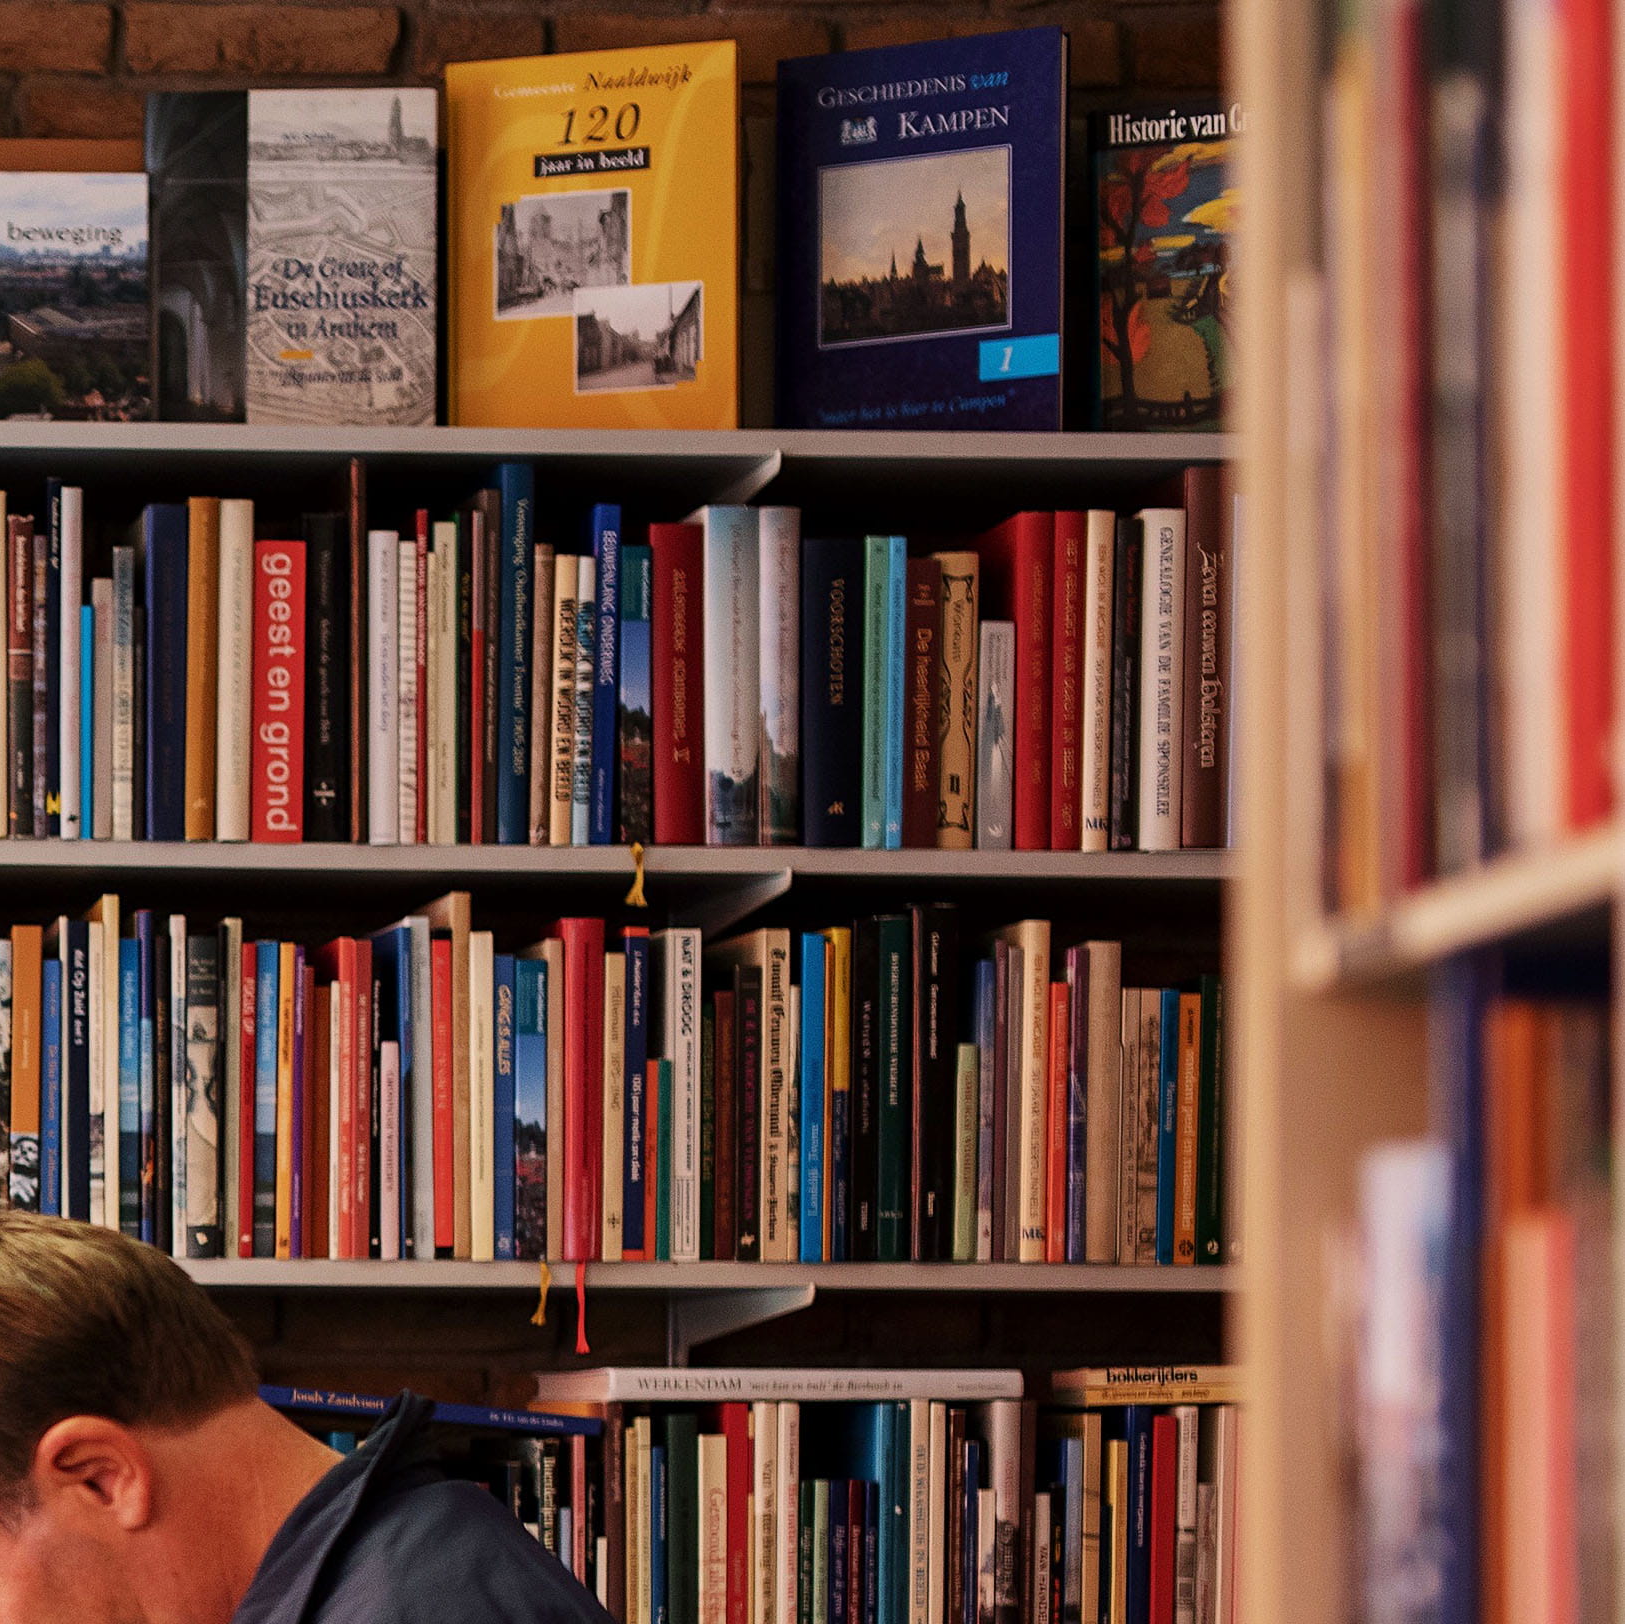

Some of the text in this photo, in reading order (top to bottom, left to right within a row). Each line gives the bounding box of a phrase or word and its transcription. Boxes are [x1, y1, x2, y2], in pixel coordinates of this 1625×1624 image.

[583, 62, 693, 92] Naaldwijk
[556, 101, 642, 147] 120
[898, 105, 1011, 141] KAMPEN
[1189, 105, 1227, 137] van
[539, 148, 646, 176] jaar in beeld
[6, 223, 124, 247] beweging
[282, 258, 314, 279] De
[317, 314, 399, 340] Arnhem
[999, 345, 1013, 373] 1
[829, 577, 846, 705] VOORSCHOTEN
[259, 553, 299, 832] geest en grond
[913, 627, 932, 793] De heerlijkheid Baak
[637, 1377, 743, 1393] WERKENDAM
[1105, 1366, 1199, 1387] bokkerijders
